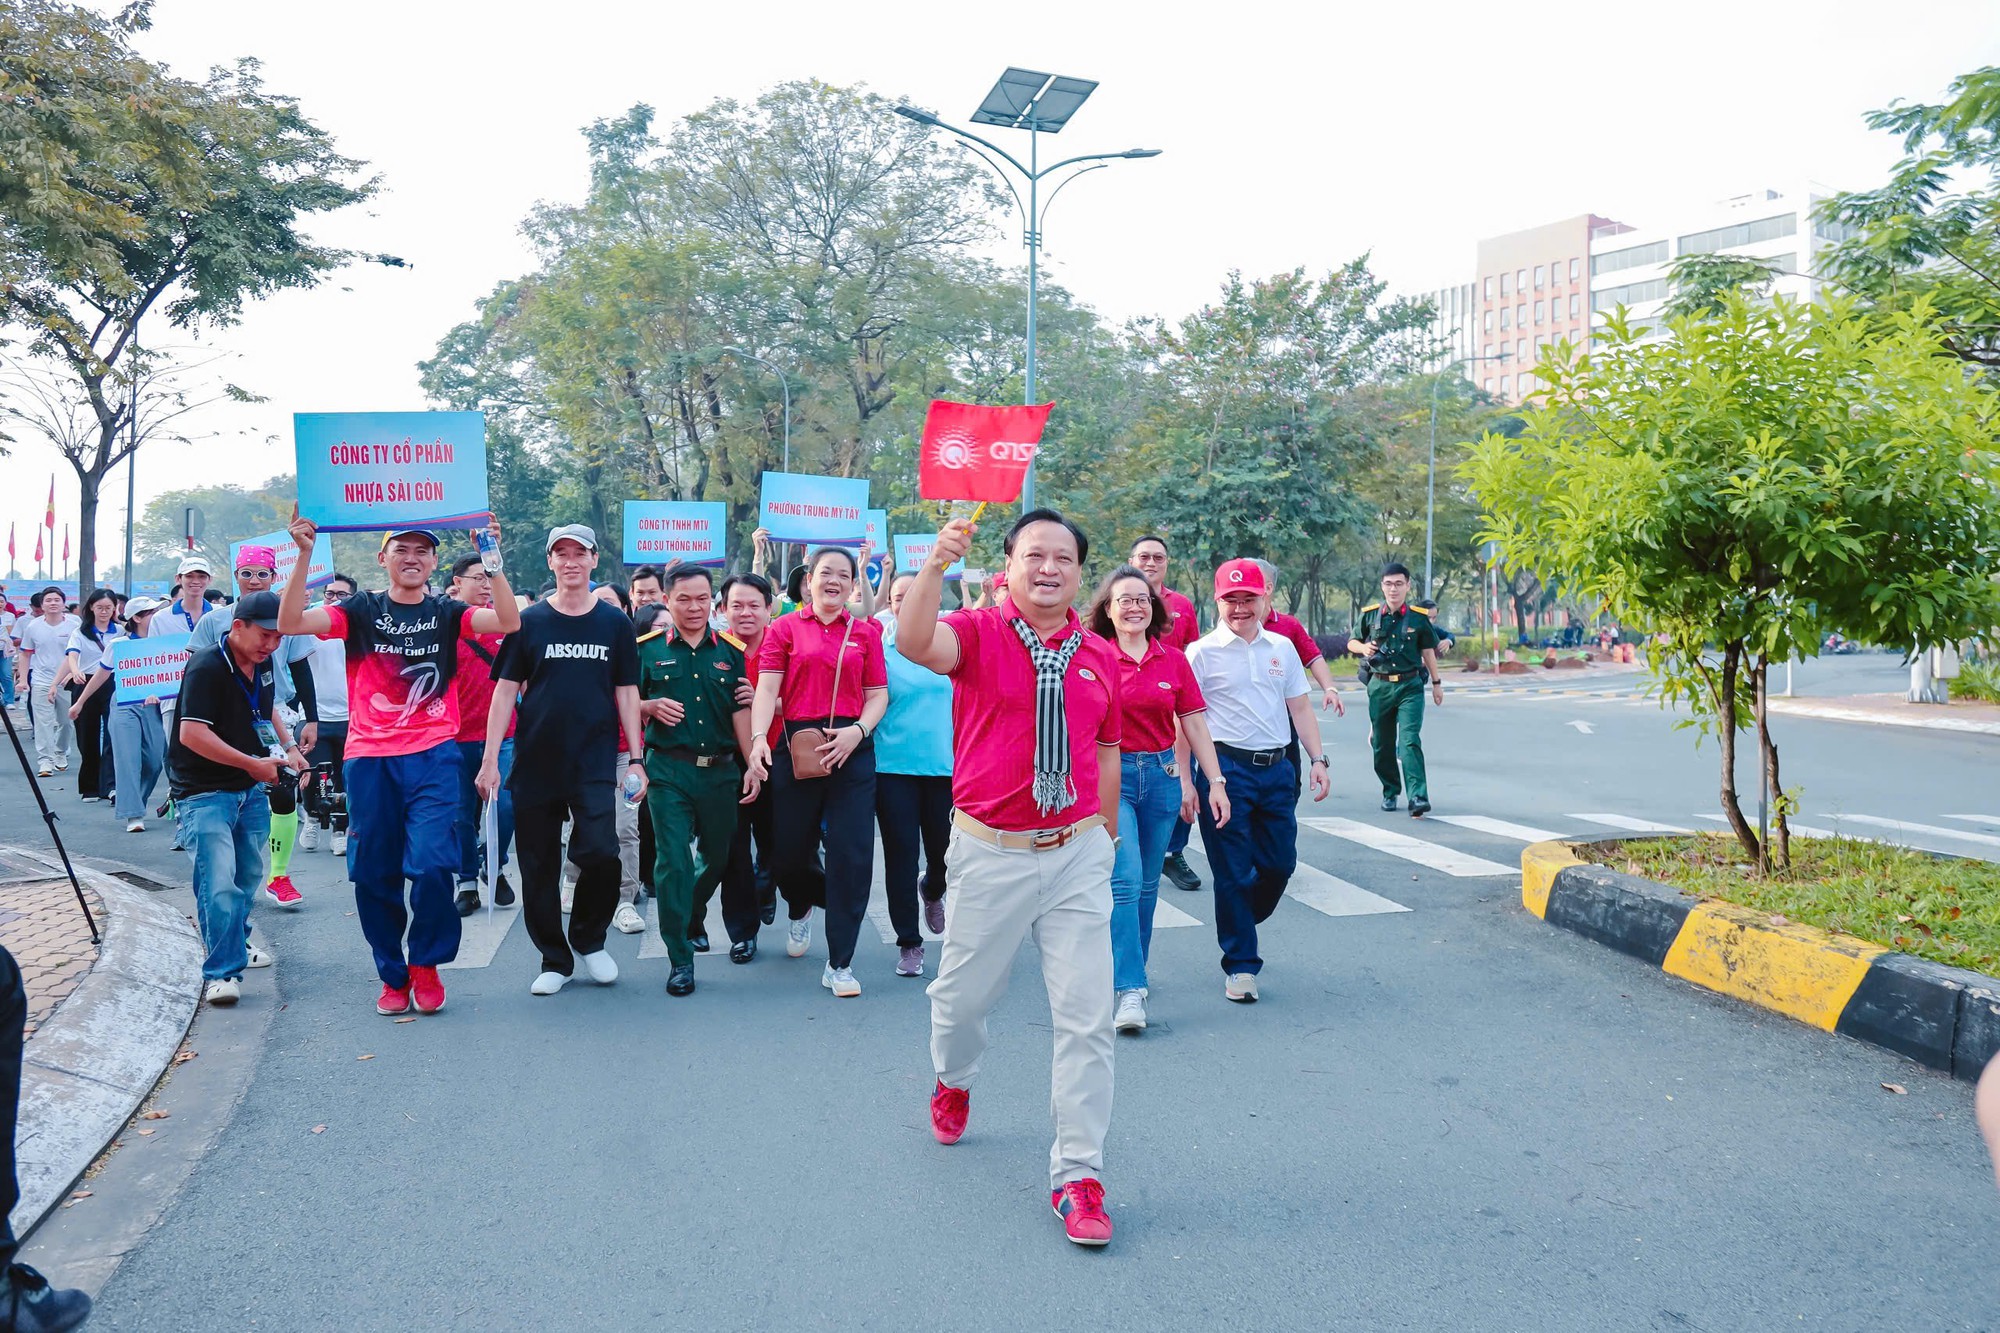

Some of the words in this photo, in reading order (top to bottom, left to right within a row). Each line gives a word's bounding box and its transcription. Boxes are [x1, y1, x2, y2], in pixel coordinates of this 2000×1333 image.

[330, 441, 370, 465] CÔNG
[373, 444, 389, 464] TY
[393, 436, 412, 464] CỔ
[415, 437, 454, 463] PHẦN
[344, 481, 384, 506] NHỰA
[388, 479, 411, 502] SÀI
[415, 477, 443, 501] GÒN
[768, 500, 801, 515] PHƯỜNG
[803, 505, 829, 518] TRUNG
[845, 506, 860, 520] TÂY
[639, 517, 660, 530] CÔNG
[661, 519, 670, 530] TY
[672, 519, 691, 531] TNHH
[693, 520, 709, 531] MTV
[637, 540, 652, 551] CAO
[654, 540, 664, 551] SU
[666, 537, 690, 551] THỐNG
[692, 537, 712, 551] NHẤT
[904, 545, 926, 554] TRUNG
[1230, 570, 1243, 582] Q
[374, 643, 403, 655] TEAM
[404, 647, 426, 656] CHO
[118, 658, 142, 670] CÔNG
[143, 656, 153, 666] TY
[121, 674, 155, 688] THƯƠNG
[157, 671, 173, 684] MẠI
